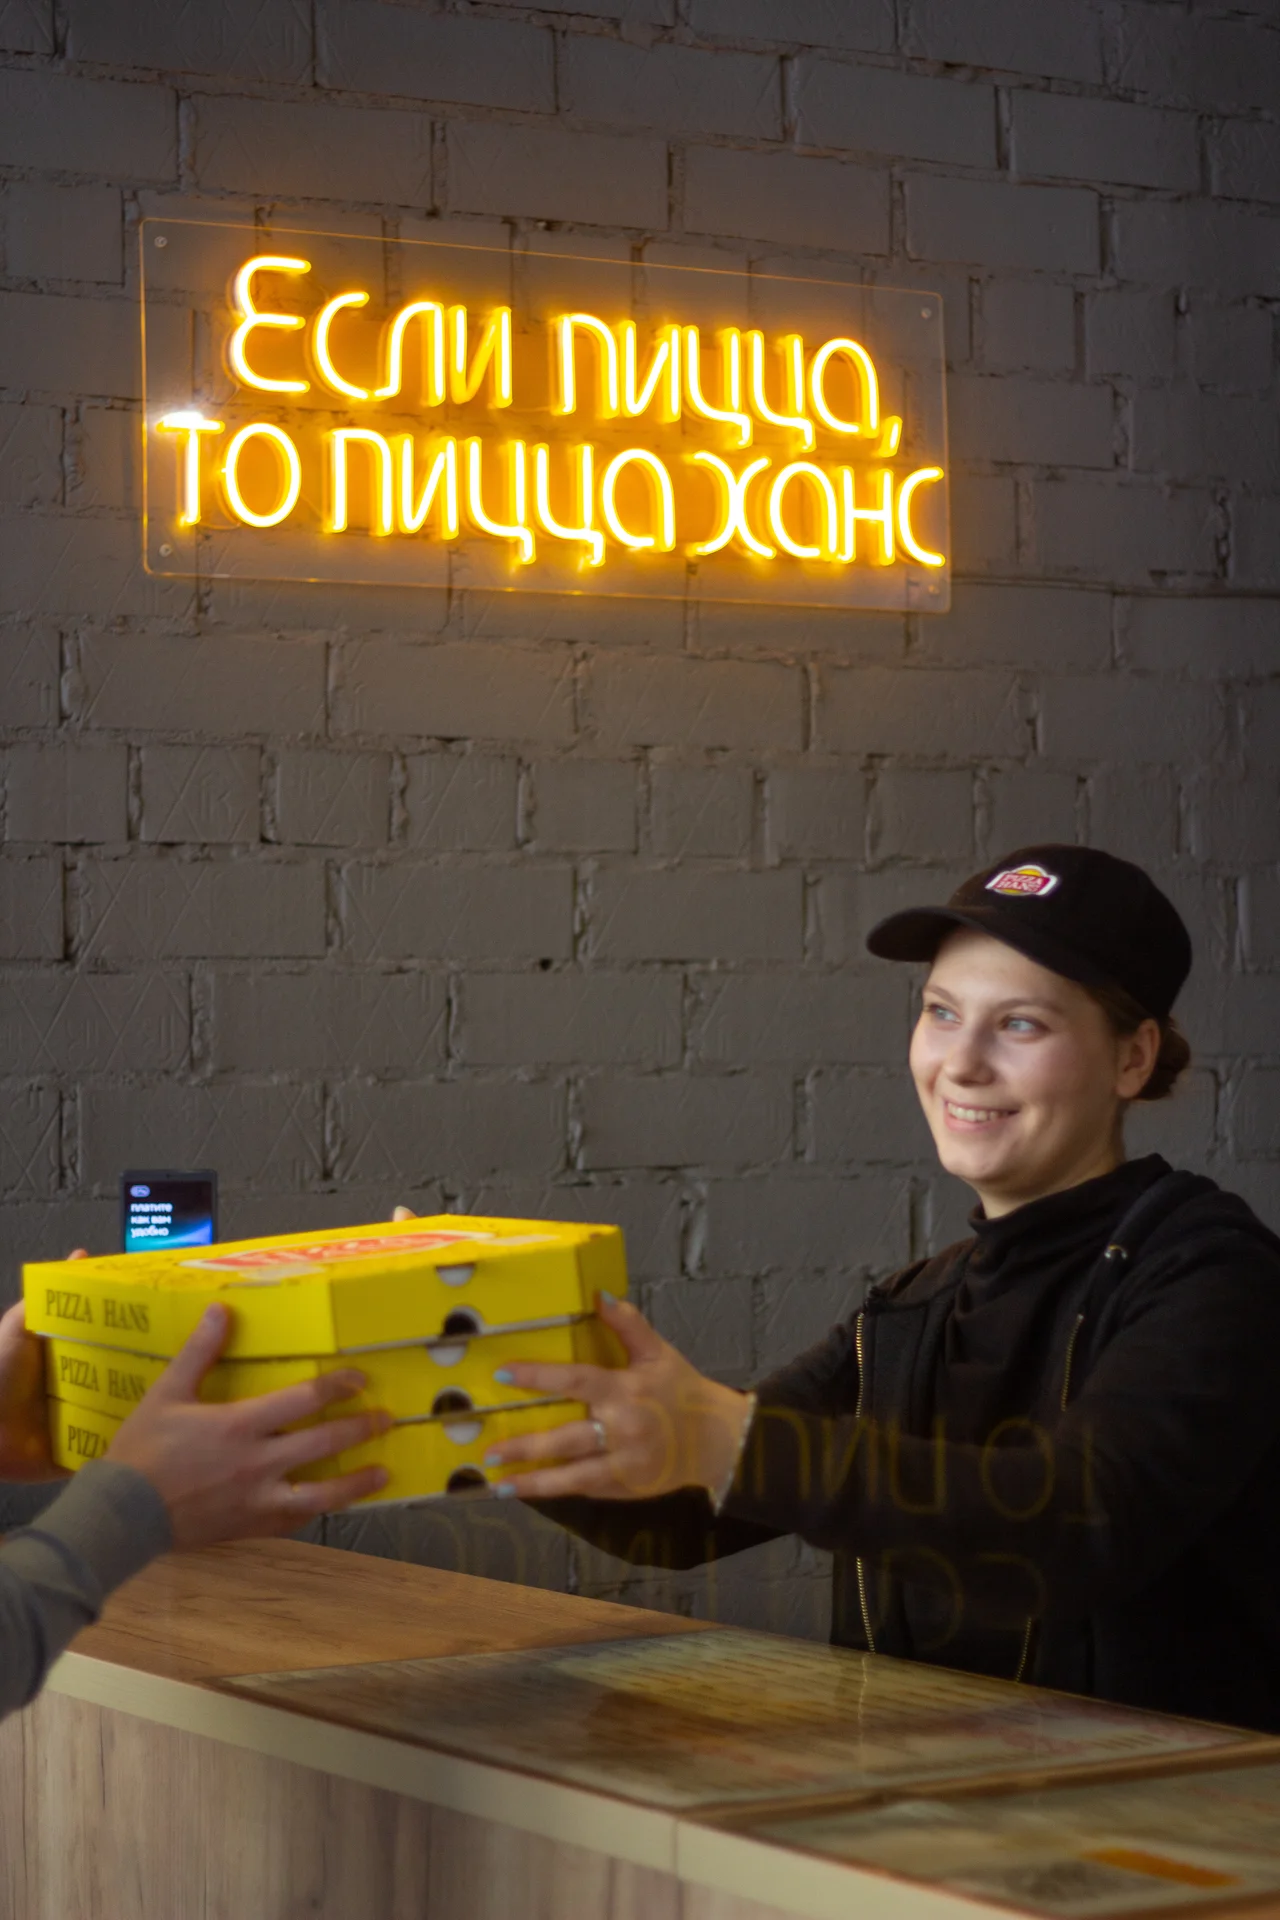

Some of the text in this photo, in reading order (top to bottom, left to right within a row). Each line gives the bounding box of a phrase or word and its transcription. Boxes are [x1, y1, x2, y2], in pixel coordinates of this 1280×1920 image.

[231, 256, 512, 410] Если
[45, 1288, 149, 1333] PIZZA HANS
[60, 1355, 99, 1392] PIZZA
